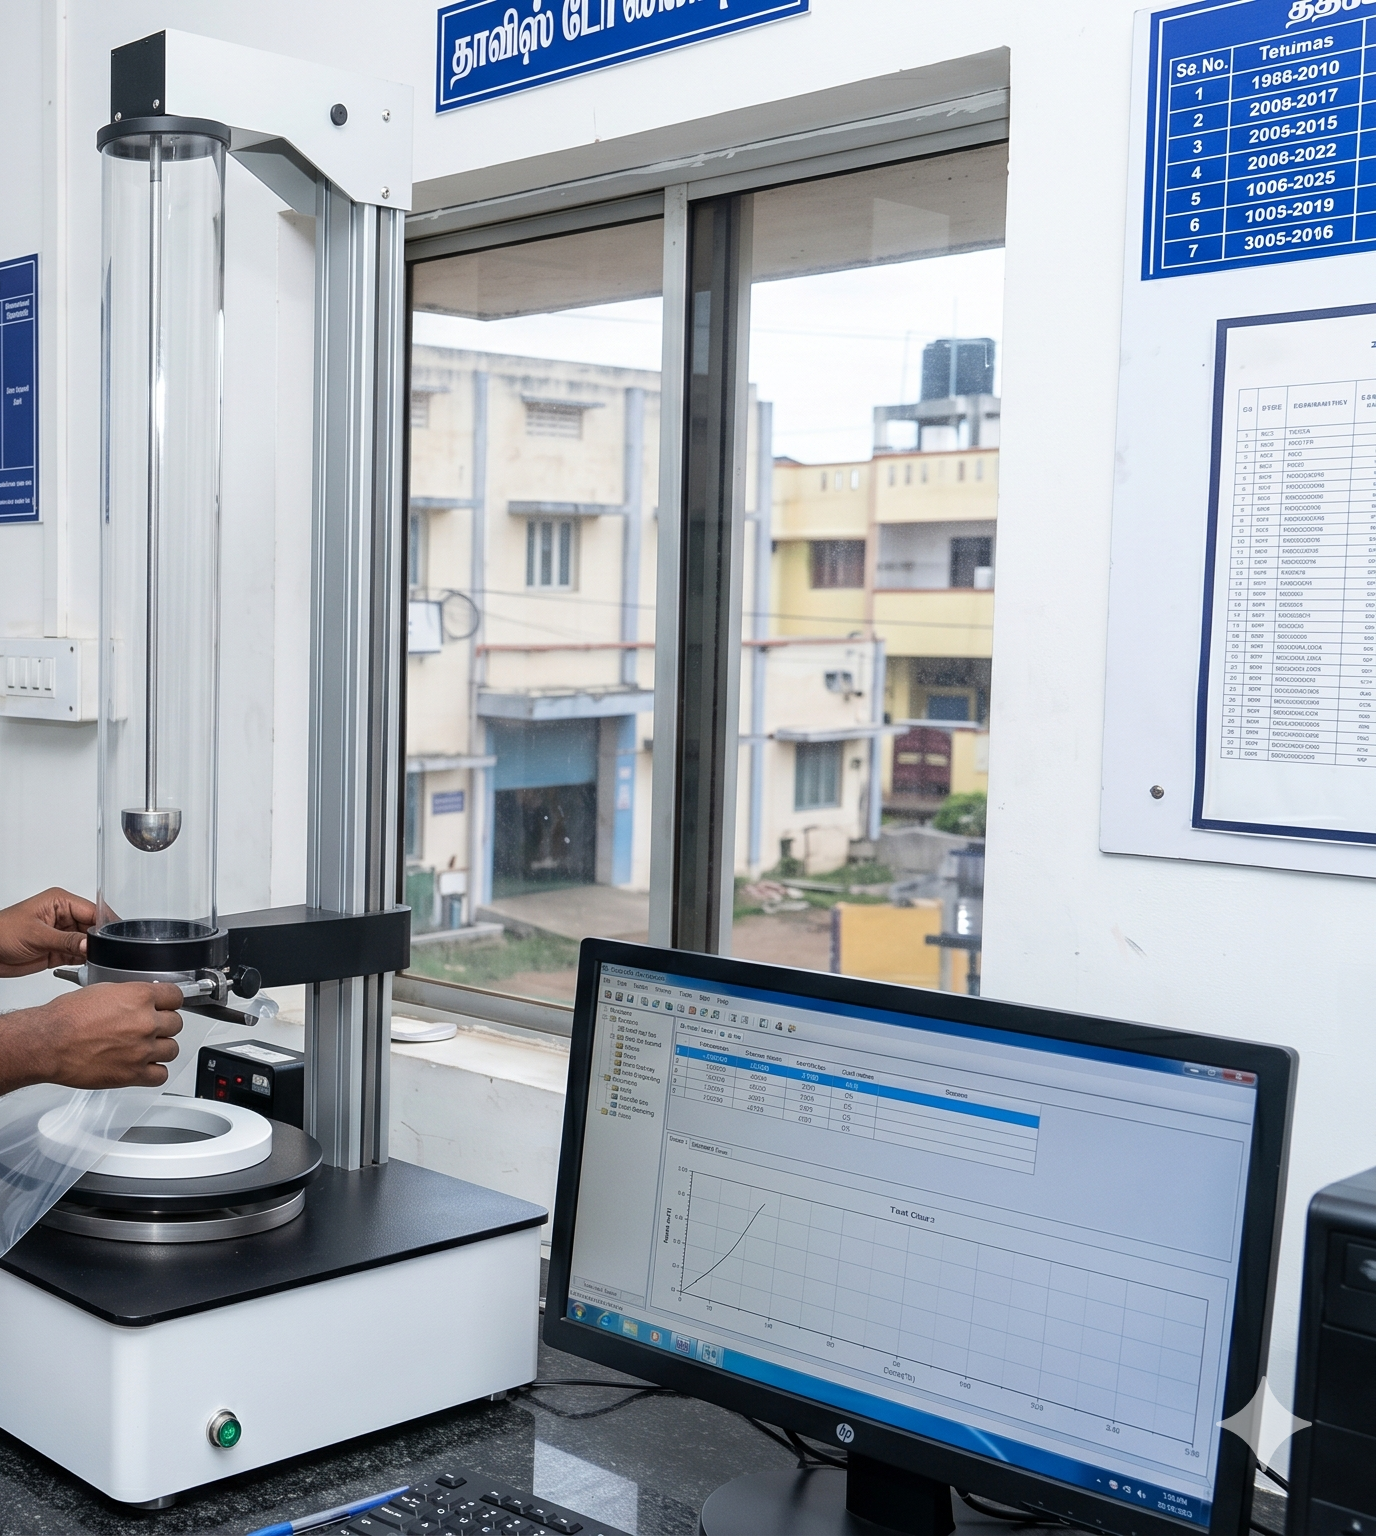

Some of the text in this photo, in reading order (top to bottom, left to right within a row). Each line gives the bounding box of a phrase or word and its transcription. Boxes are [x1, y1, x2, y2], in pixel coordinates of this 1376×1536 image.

[1195, 87, 1203, 100] 1
[1193, 113, 1204, 127] 2
[1193, 115, 1338, 153] 3 2005-2015
[1191, 166, 1202, 179] 4
[1191, 170, 1336, 206] 5 1006-2025
[1189, 218, 1200, 232] 6
[1188, 244, 1198, 258] 7
